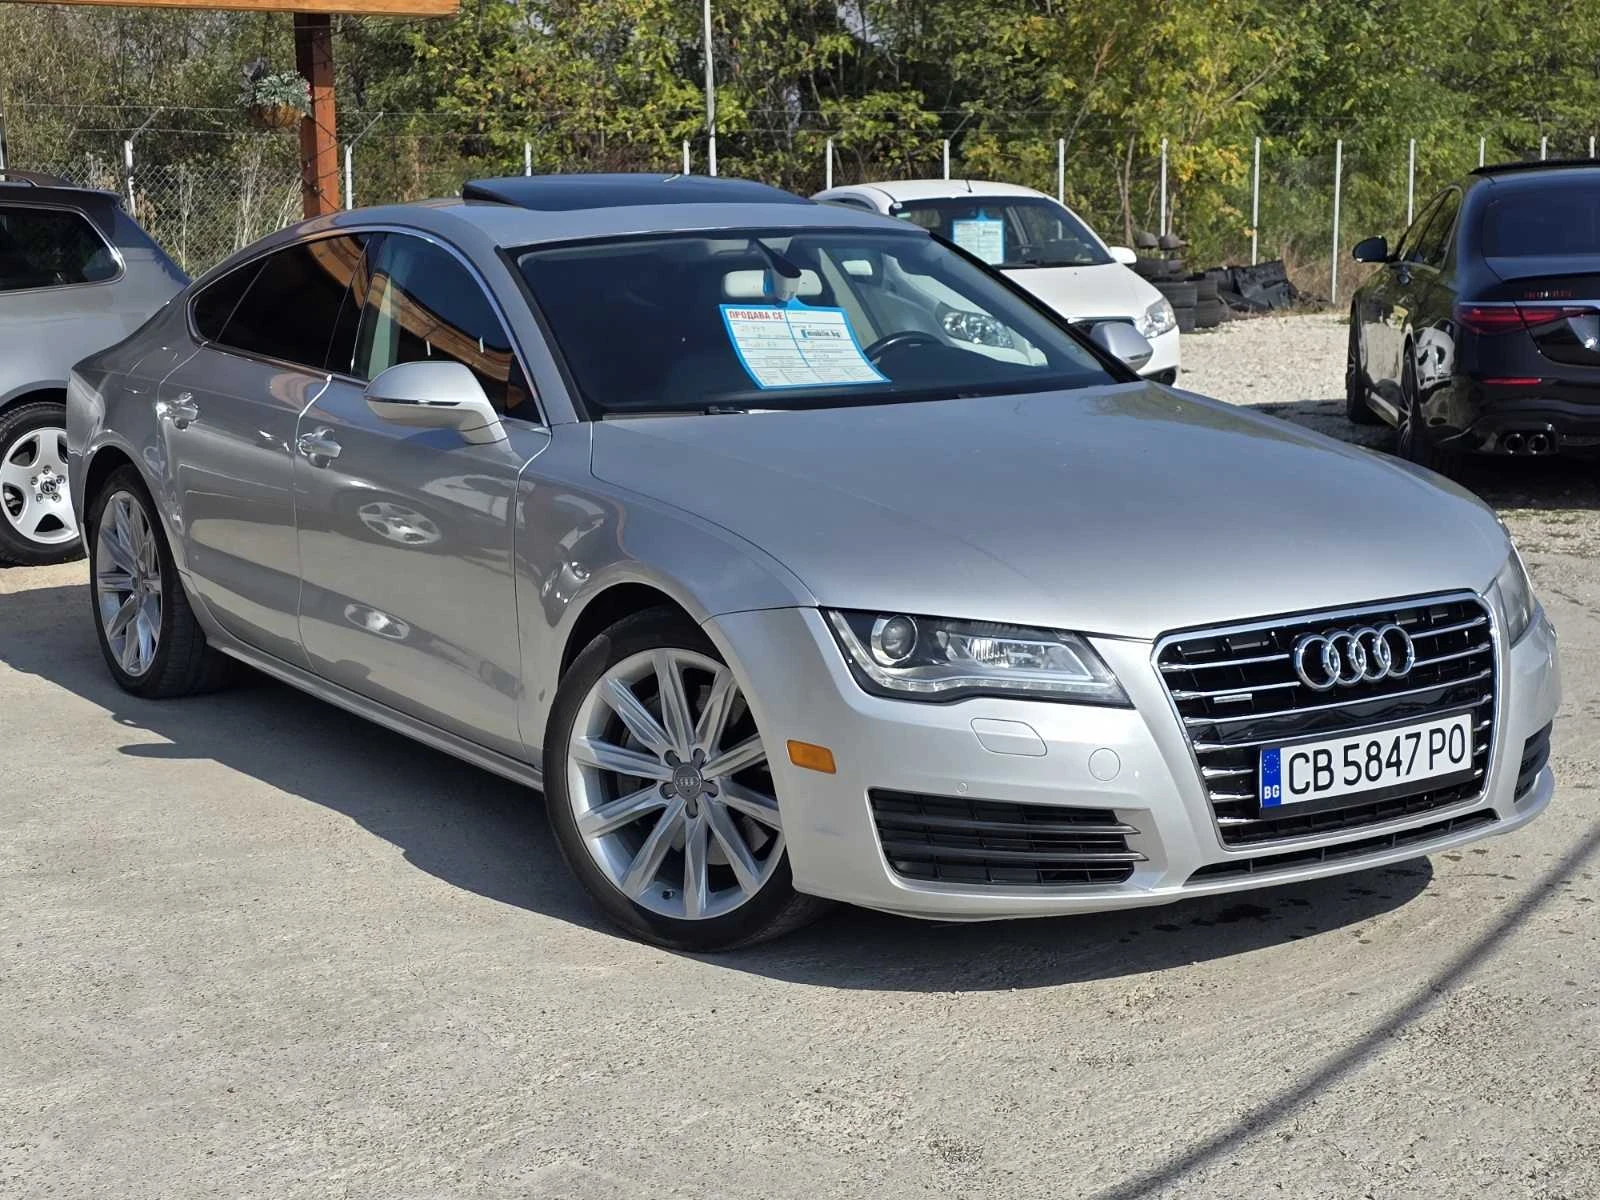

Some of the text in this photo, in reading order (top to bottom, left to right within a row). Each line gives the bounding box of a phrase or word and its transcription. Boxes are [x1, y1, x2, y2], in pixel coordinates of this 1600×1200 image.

[729, 311, 770, 320] ПРОДАВА
[772, 311, 784, 320] СЕ
[1288, 748, 1335, 795] CB
[1343, 731, 1422, 786] 5847
[1264, 785, 1280, 799] BG
